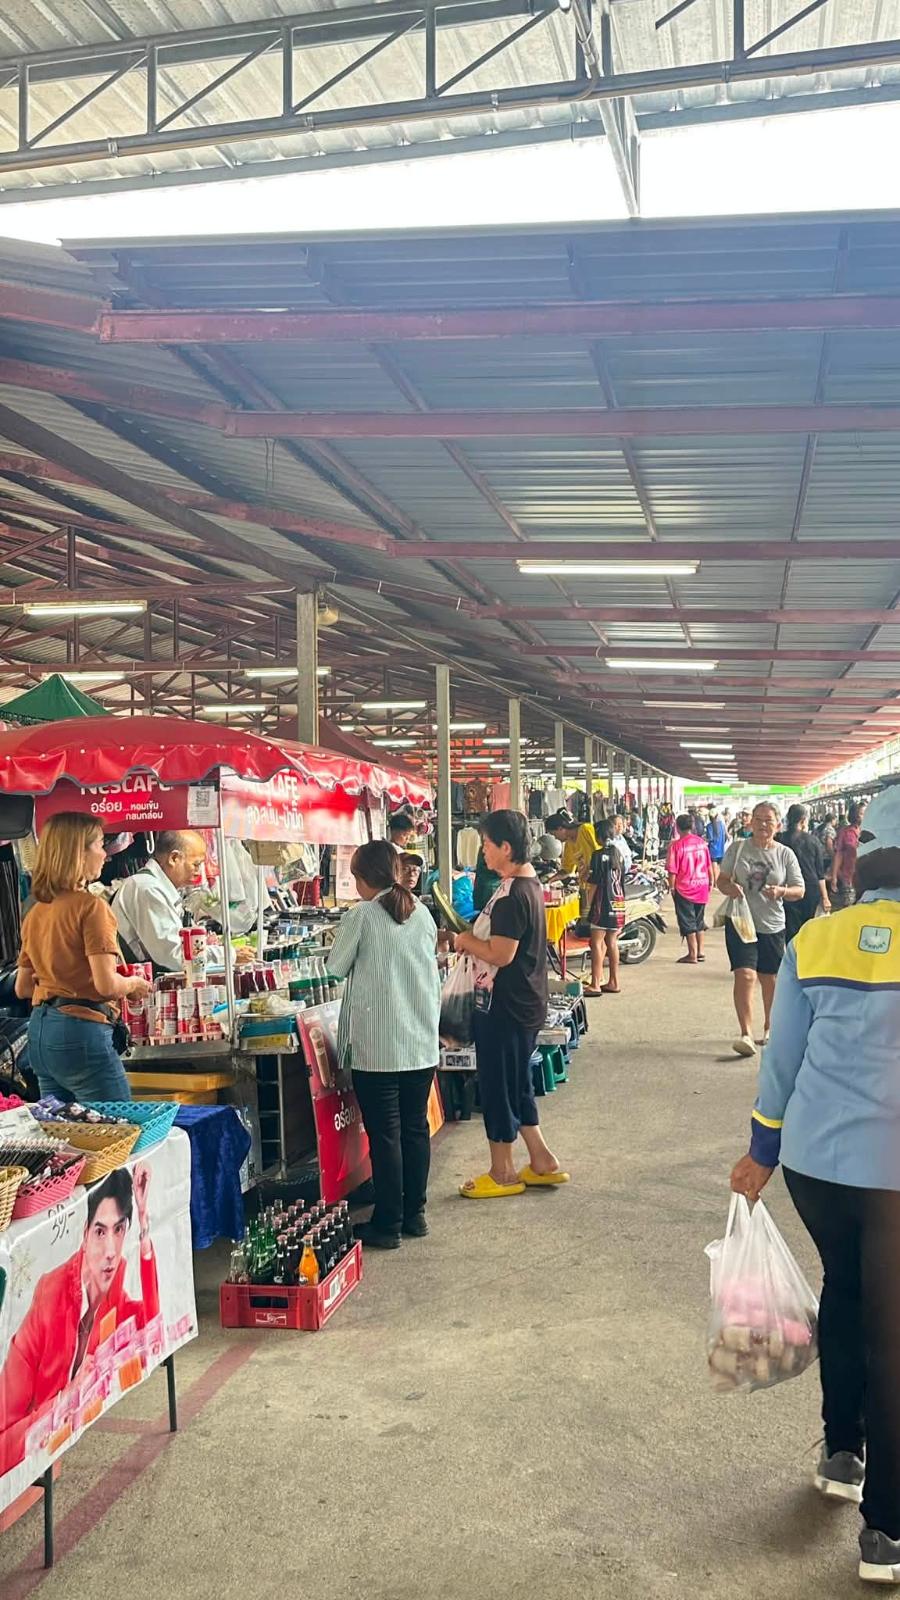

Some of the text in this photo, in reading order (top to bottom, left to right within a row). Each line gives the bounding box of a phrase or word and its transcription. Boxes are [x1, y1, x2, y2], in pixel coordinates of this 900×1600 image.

[125, 810, 163, 821] กลมกล่อม
[686, 849, 707, 878] 12
